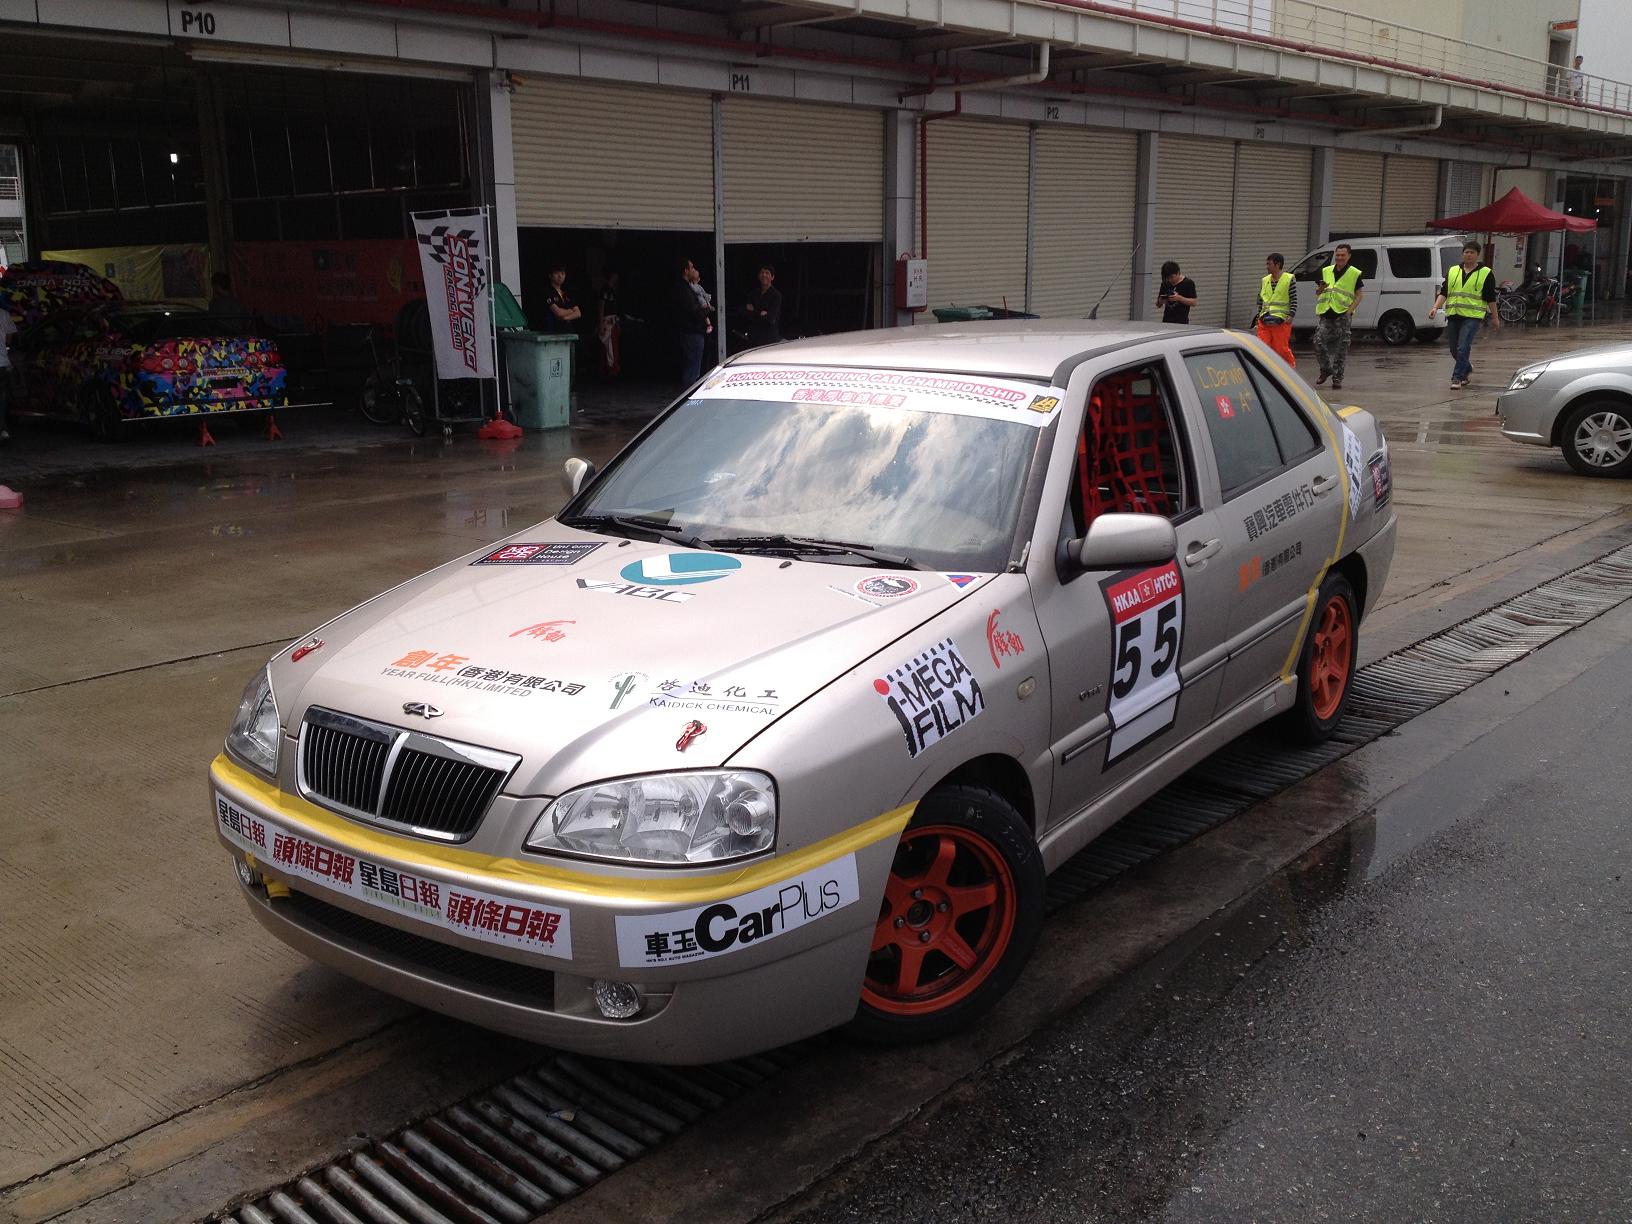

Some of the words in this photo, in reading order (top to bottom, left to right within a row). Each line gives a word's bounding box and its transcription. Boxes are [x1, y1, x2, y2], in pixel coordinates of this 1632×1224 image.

[181, 10, 215, 34] P10
[732, 74, 749, 91] P11
[1047, 106, 1059, 120] P12
[450, 238, 471, 294] SON
[446, 268, 459, 313] RACING
[451, 316, 463, 350] TEAM
[459, 301, 477, 370] VENG
[727, 372, 765, 383] HONG
[764, 371, 806, 380] KONG
[806, 371, 868, 382] TOURING
[871, 374, 902, 384] CAR
[903, 376, 1026, 402] CHAMPIONSHIP
[1114, 588, 1141, 613] HKAA
[1153, 570, 1178, 594] HTCC
[1113, 600, 1177, 699] 55
[381, 668, 414, 678] YEAR
[414, 672, 532, 698] FULL(HK)LIMITED
[650, 697, 703, 709] KAIDICK
[707, 702, 776, 716] CHEMICAL
[912, 678, 985, 751] FILM
[218, 798, 267, 849] 星島日報
[273, 832, 356, 885] 頭條日報
[359, 860, 442, 911] 星島日報
[447, 892, 562, 943] 頭條日報
[694, 879, 841, 953] CarPlus
[645, 928, 697, 958] 車王
